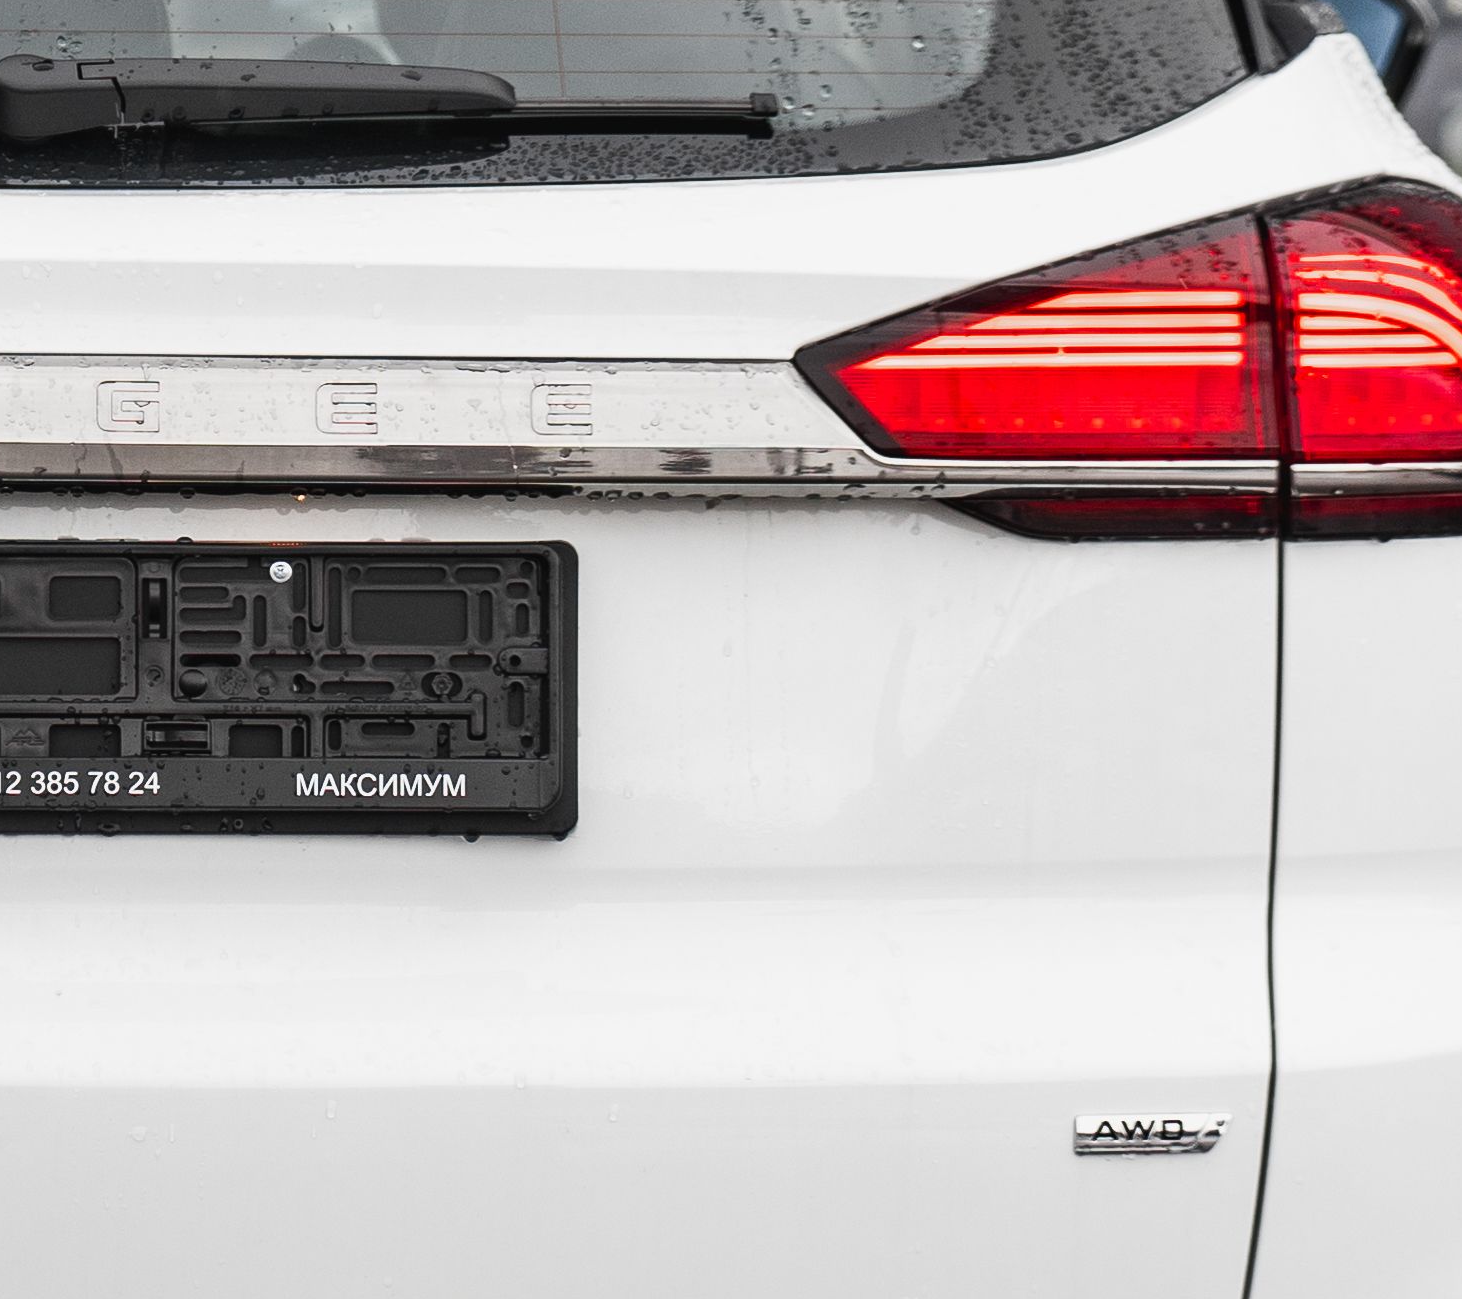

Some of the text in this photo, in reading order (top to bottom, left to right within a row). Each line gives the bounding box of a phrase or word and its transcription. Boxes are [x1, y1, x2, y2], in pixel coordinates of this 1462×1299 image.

[30, 771, 79, 795] 385
[88, 771, 120, 795] 78
[128, 771, 161, 795] 24
[295, 772, 466, 797] МАКСИМУМ
[1091, 1119, 1183, 1141] AWD
